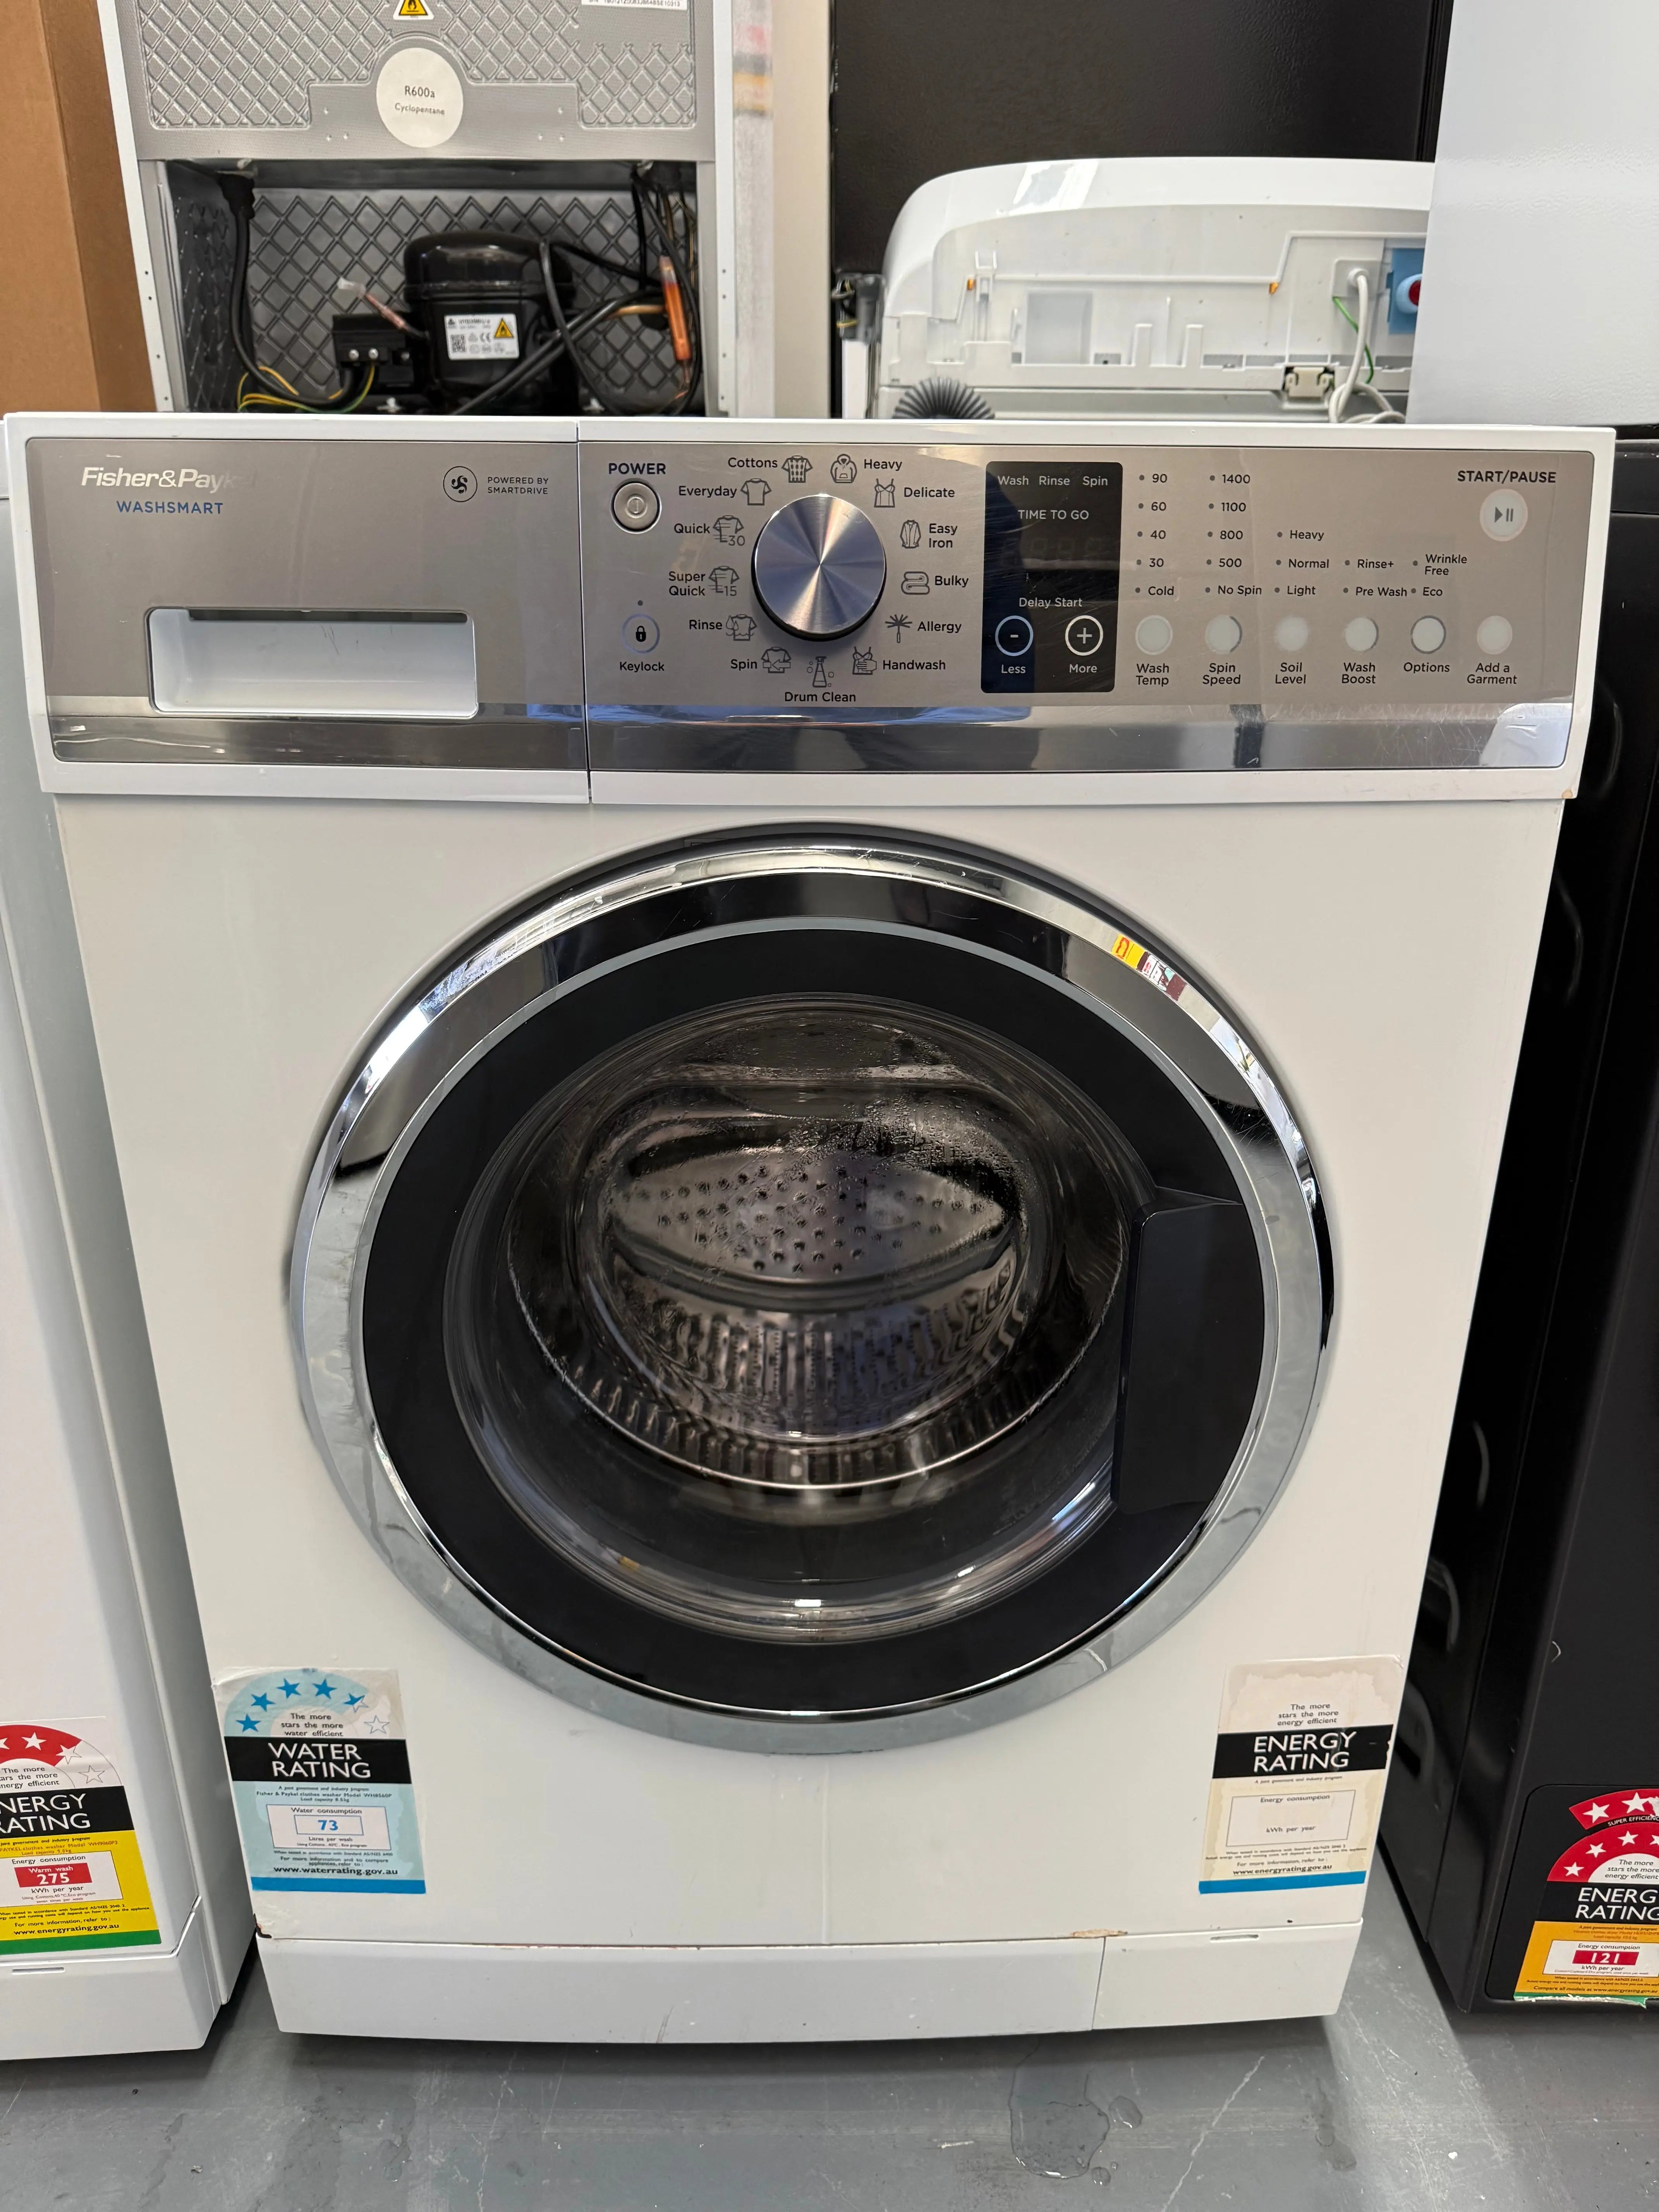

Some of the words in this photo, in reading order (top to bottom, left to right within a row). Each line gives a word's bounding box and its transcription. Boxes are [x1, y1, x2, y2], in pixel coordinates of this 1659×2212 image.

[405, 85, 435, 98] R600a
[395, 102, 445, 115] Cyclopentane
[728, 457, 778, 469] Cottons
[864, 459, 902, 472] Heavy
[608, 463, 666, 475] POWER
[998, 476, 1029, 486] Wash
[1039, 476, 1070, 486] Rinse
[1083, 476, 1108, 488] Spin
[1152, 474, 1168, 483] 90
[1222, 474, 1250, 484] 1400
[1458, 470, 1556, 484] START/PAUSE
[678, 486, 737, 498] Everyday
[904, 487, 955, 498] Delicate
[117, 501, 223, 514] WASHSMART
[1151, 502, 1166, 512] 60
[1221, 502, 1246, 512] 1100
[1018, 510, 1046, 519] TIME
[1051, 510, 1066, 519] TO
[1071, 510, 1089, 520] GO
[674, 524, 710, 534] Quick
[929, 524, 957, 536] Easy
[1151, 530, 1166, 539] 40
[1219, 531, 1243, 540] 800
[1290, 530, 1324, 541] Heavy
[729, 535, 745, 546] 30
[929, 538, 953, 548] Iron
[1149, 558, 1164, 567] 30
[1219, 558, 1242, 568] 500
[1288, 559, 1329, 568] Normal
[1357, 559, 1394, 568] Rinse+
[1425, 554, 1467, 564] Wrinkle
[1425, 566, 1449, 575] Free
[668, 572, 705, 584] Super
[934, 576, 969, 588] Bulky
[669, 585, 705, 597] Quick
[724, 586, 737, 596] 15
[1148, 586, 1174, 596] Cold
[1218, 586, 1234, 595] No
[1237, 585, 1262, 596] Spin
[1287, 586, 1316, 596] Light
[1356, 587, 1373, 596] Pre
[1377, 587, 1407, 597] Wash
[1423, 587, 1443, 596] Eco
[1019, 598, 1051, 610] Delay
[1055, 598, 1082, 607] Start
[689, 620, 722, 630] Rinse
[917, 622, 962, 634] Allergy
[620, 662, 665, 673] Keylock
[731, 659, 757, 670] Spin
[883, 660, 945, 670] Handwash
[1001, 665, 1026, 673] Less
[1069, 664, 1097, 673] More
[1137, 663, 1169, 673] Wash
[1209, 663, 1236, 674] Spin
[1280, 663, 1302, 672] Soil
[1343, 663, 1376, 672] Wash
[1403, 663, 1450, 673] Options
[1475, 663, 1498, 672] Add
[1136, 675, 1169, 687] Temp
[1202, 675, 1241, 686] Speed
[1275, 674, 1306, 684] Level
[1342, 674, 1376, 684] Boost
[1467, 675, 1517, 685] Garment
[785, 692, 817, 702] Drum
[822, 692, 856, 702] Clean
[1254, 1731, 1357, 1753] ENERGY
[268, 1743, 362, 1760] WATER
[1254, 1752, 1349, 1772] RATING
[272, 1761, 371, 1778] RATING
[0, 1793, 86, 1814] NERGY
[318, 1820, 338, 1831] 73
[1608, 1818, 1627, 1826] SUPER
[274, 1867, 398, 1875] www.waterrating.gov.au
[37, 1873, 70, 1885] 275
[1578, 1887, 1659, 1904] ENERG
[14, 1923, 119, 1935] www.energyrating.gov.au
[1591, 1952, 1620, 1964] 121
